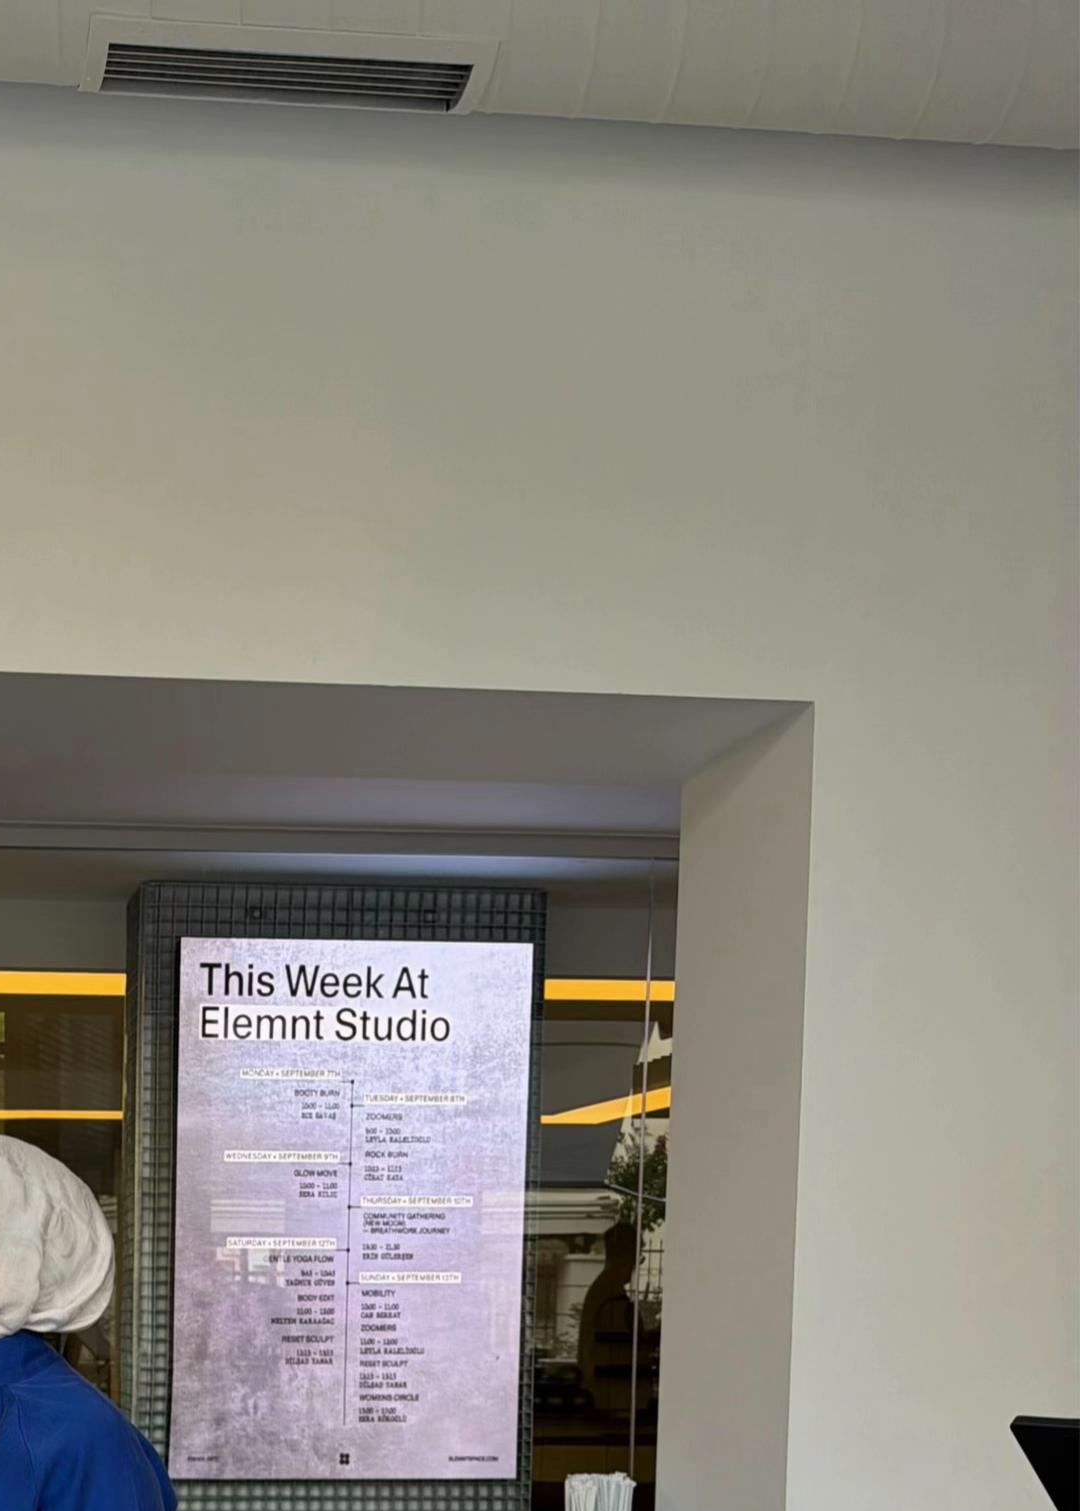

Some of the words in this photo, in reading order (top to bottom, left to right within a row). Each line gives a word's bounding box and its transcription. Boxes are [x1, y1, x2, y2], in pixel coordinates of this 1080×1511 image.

[200, 962, 275, 997] This
[285, 964, 384, 999] Week
[392, 966, 429, 999] At
[201, 1006, 325, 1040] Elemnt
[335, 1007, 451, 1042] Studio
[294, 1089, 318, 1097] BOOTY
[319, 1089, 340, 1097] BURN
[387, 1151, 408, 1159] BURN
[293, 1169, 315, 1177] GLOW
[316, 1169, 338, 1177] MOVE
[362, 1196, 402, 1204] THURSDAY
[408, 1196, 452, 1204] SEPTEMBER
[363, 1212, 405, 1220] COMMUNITY
[406, 1212, 446, 1220] GATHERING
[263, 1255, 291, 1263] ENLE
[292, 1255, 313, 1263] YOGA
[313, 1255, 334, 1263] FLOW
[361, 1273, 390, 1281] SUNDAY
[361, 1289, 396, 1297] MOBILITY
[297, 1294, 318, 1302] BODY
[360, 1324, 397, 1332] ZOOMERS
[281, 1335, 305, 1343] RESET
[306, 1335, 334, 1343] SCULPT
[359, 1360, 381, 1368] RESET
[393, 1393, 420, 1402] CIRCLE
